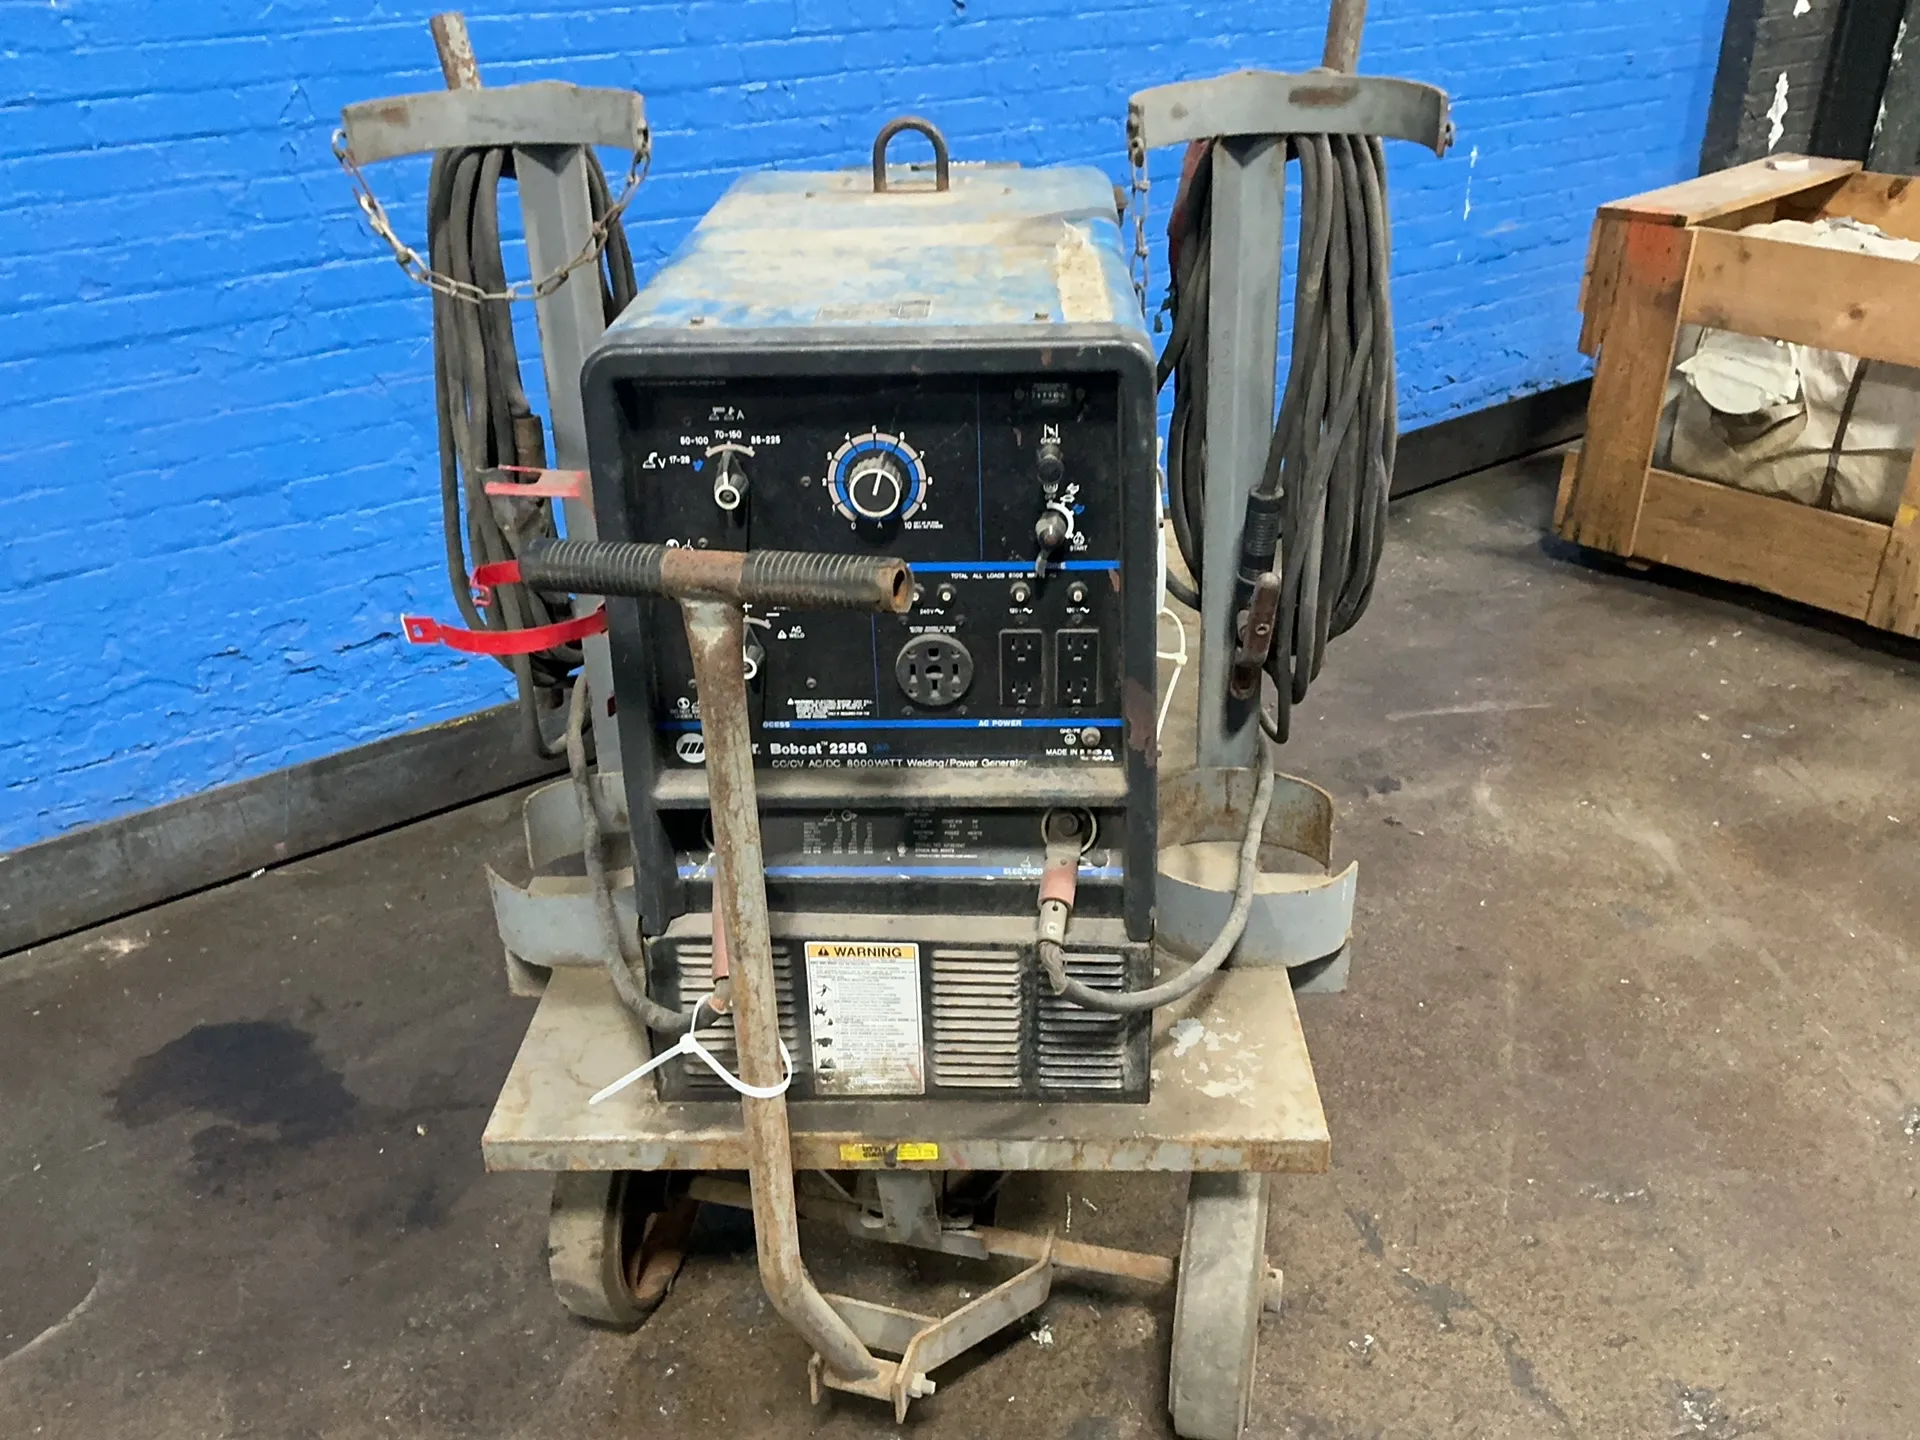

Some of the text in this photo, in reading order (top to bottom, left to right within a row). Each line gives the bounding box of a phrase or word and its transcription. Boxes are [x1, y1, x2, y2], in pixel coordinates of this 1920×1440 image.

[737, 409, 745, 420] A
[714, 430, 742, 439] 70-150
[844, 432, 850, 440] 4
[920, 450, 925, 460] 7
[658, 458, 666, 469] V
[904, 521, 912, 530] 10
[762, 721, 790, 729] OCESS
[829, 742, 867, 755] 225G
[772, 759, 804, 769] CC/CV
[808, 759, 840, 769] AC/DC
[981, 758, 1027, 767] Generator
[1003, 867, 1043, 876] ELECROD
[834, 946, 902, 958] WARNING
